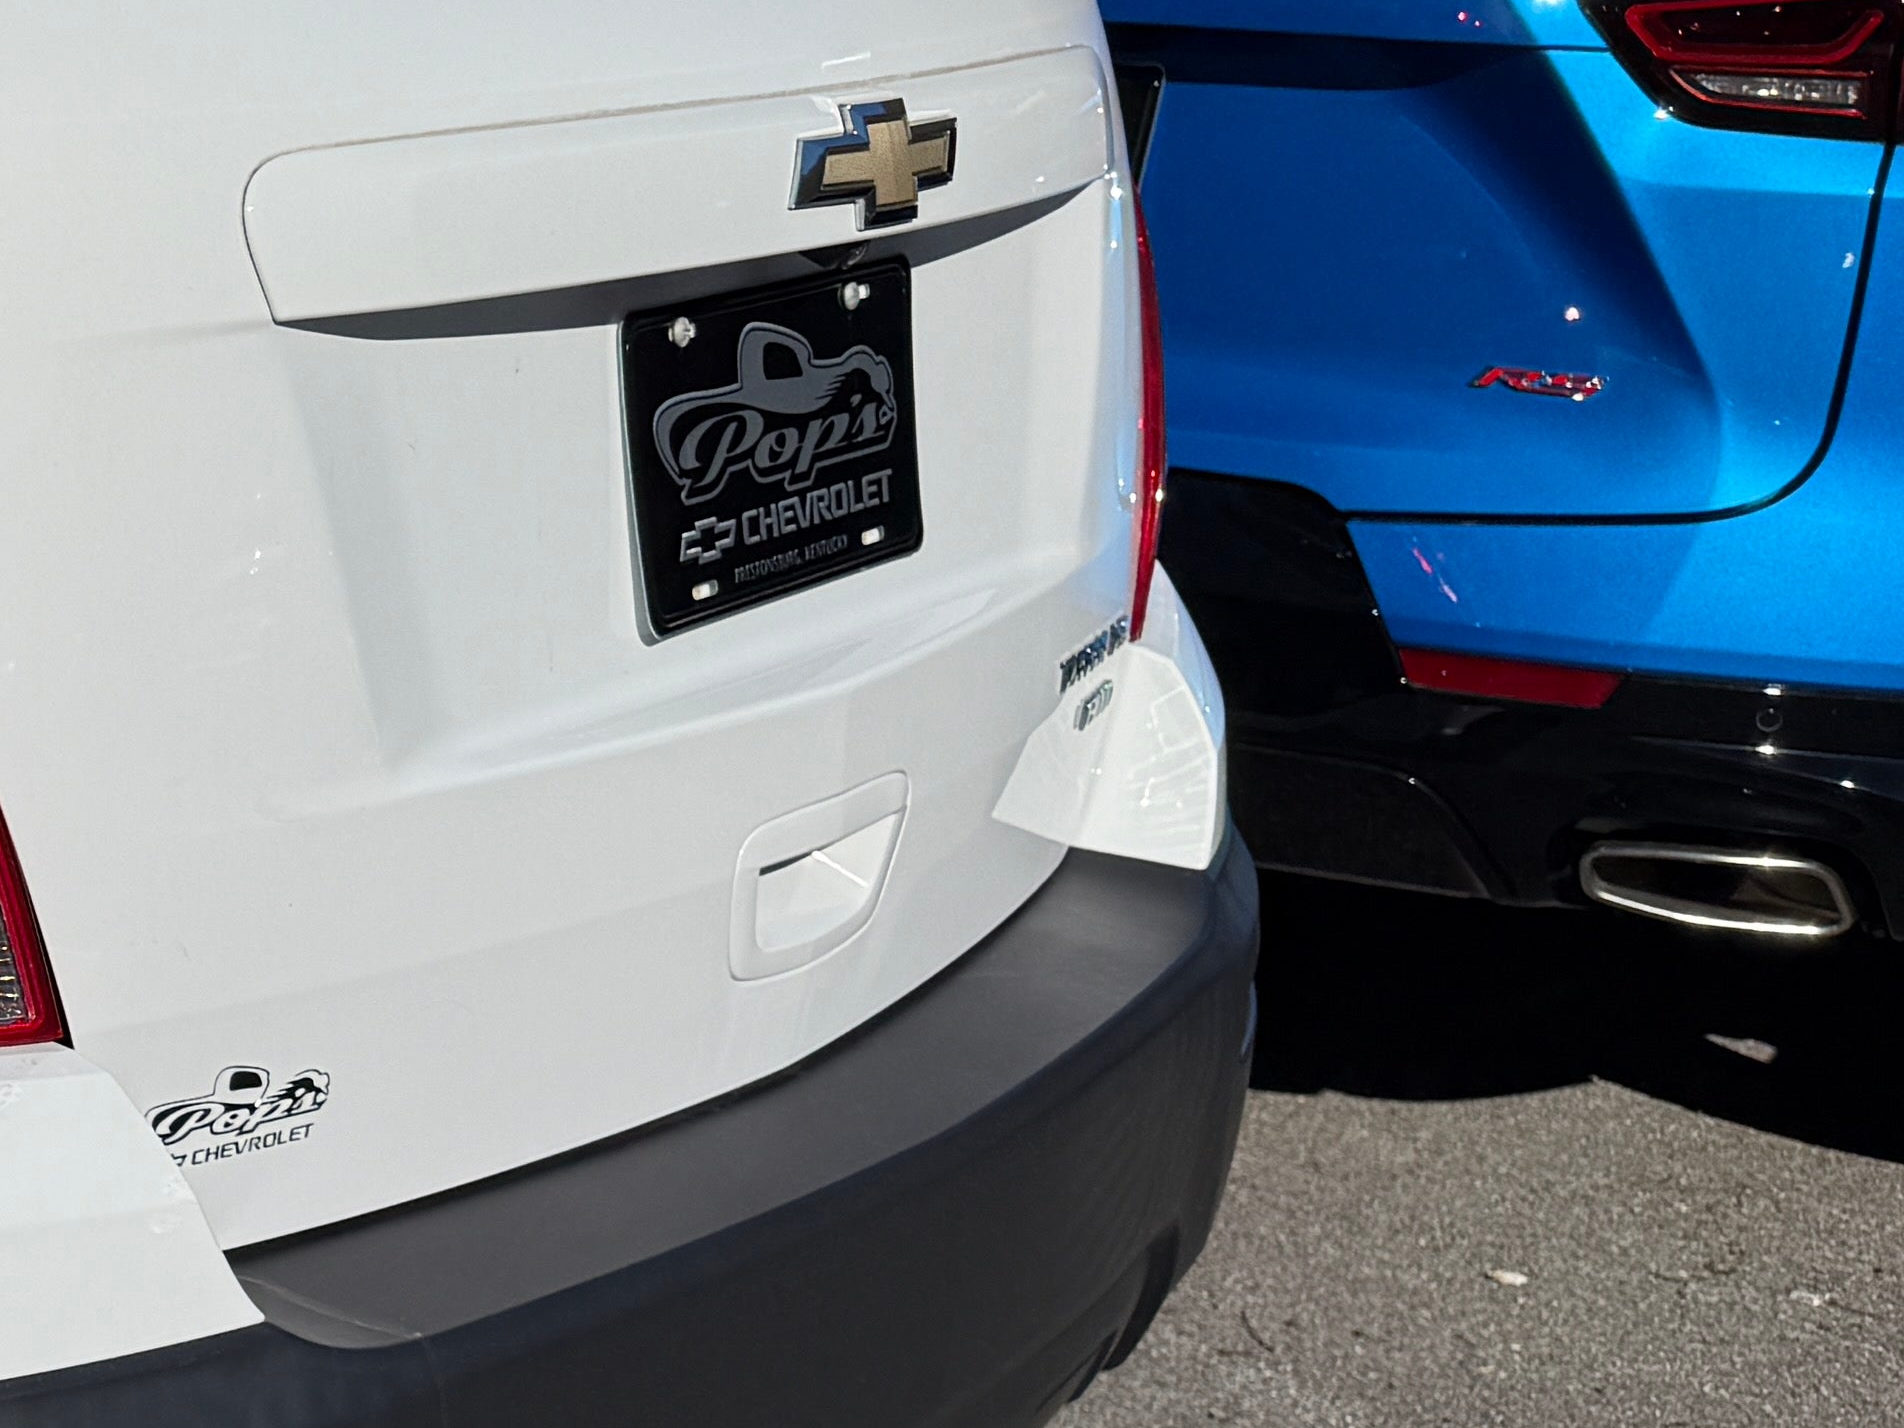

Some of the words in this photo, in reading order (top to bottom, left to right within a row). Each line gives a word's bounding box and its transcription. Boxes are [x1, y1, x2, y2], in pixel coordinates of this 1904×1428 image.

[678, 394, 886, 489] Pop's
[741, 469, 893, 545] CHEVROLET
[191, 1122, 315, 1166] CHEVROLET
